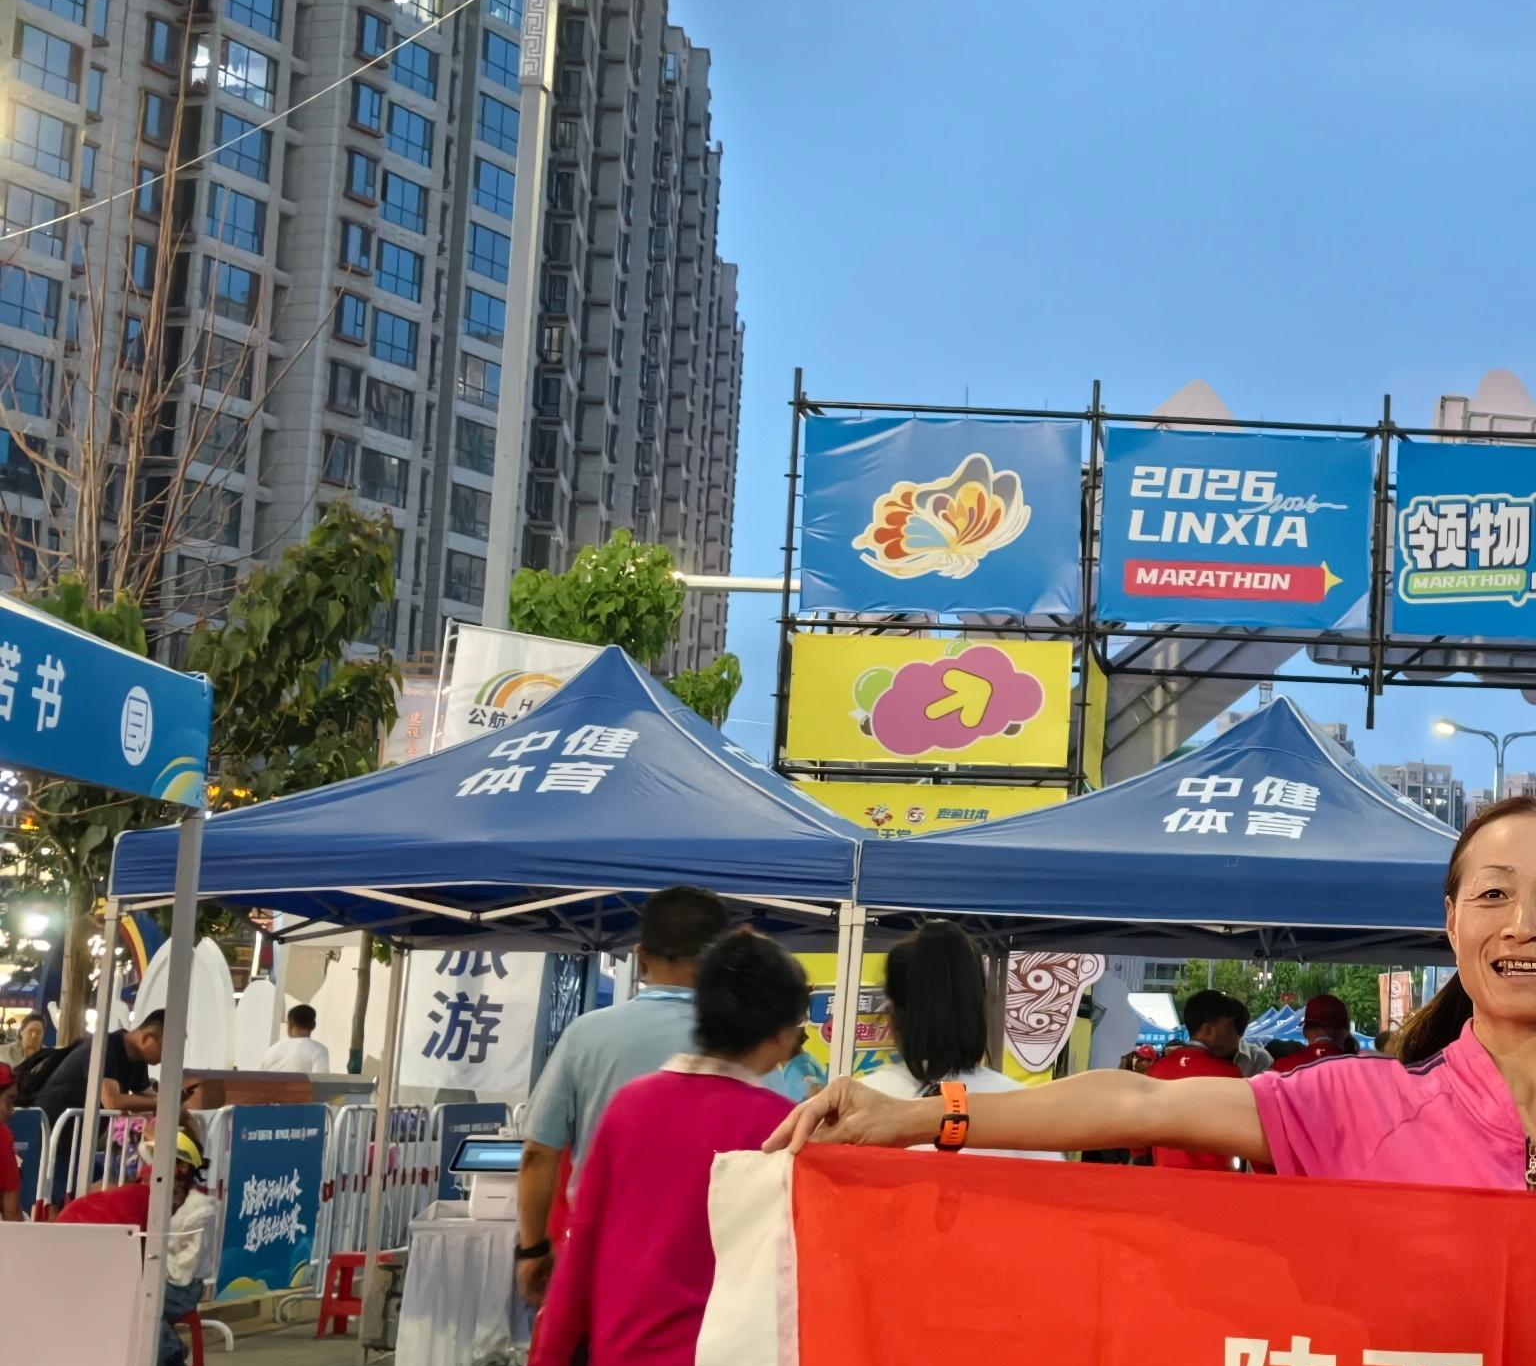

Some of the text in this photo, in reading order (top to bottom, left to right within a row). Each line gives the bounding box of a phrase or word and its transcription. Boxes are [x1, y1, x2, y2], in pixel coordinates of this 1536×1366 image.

[1130, 466, 1278, 503] 2026
[1128, 510, 1308, 548] LINXIA
[1136, 567, 1291, 590] MARATHON
[1412, 573, 1521, 590] MARATHON
[468, 707, 518, 729] 公航
[488, 725, 639, 761] 中健
[455, 762, 615, 797] 体育
[1176, 775, 1320, 811] 中健
[1163, 808, 1311, 839] 体育
